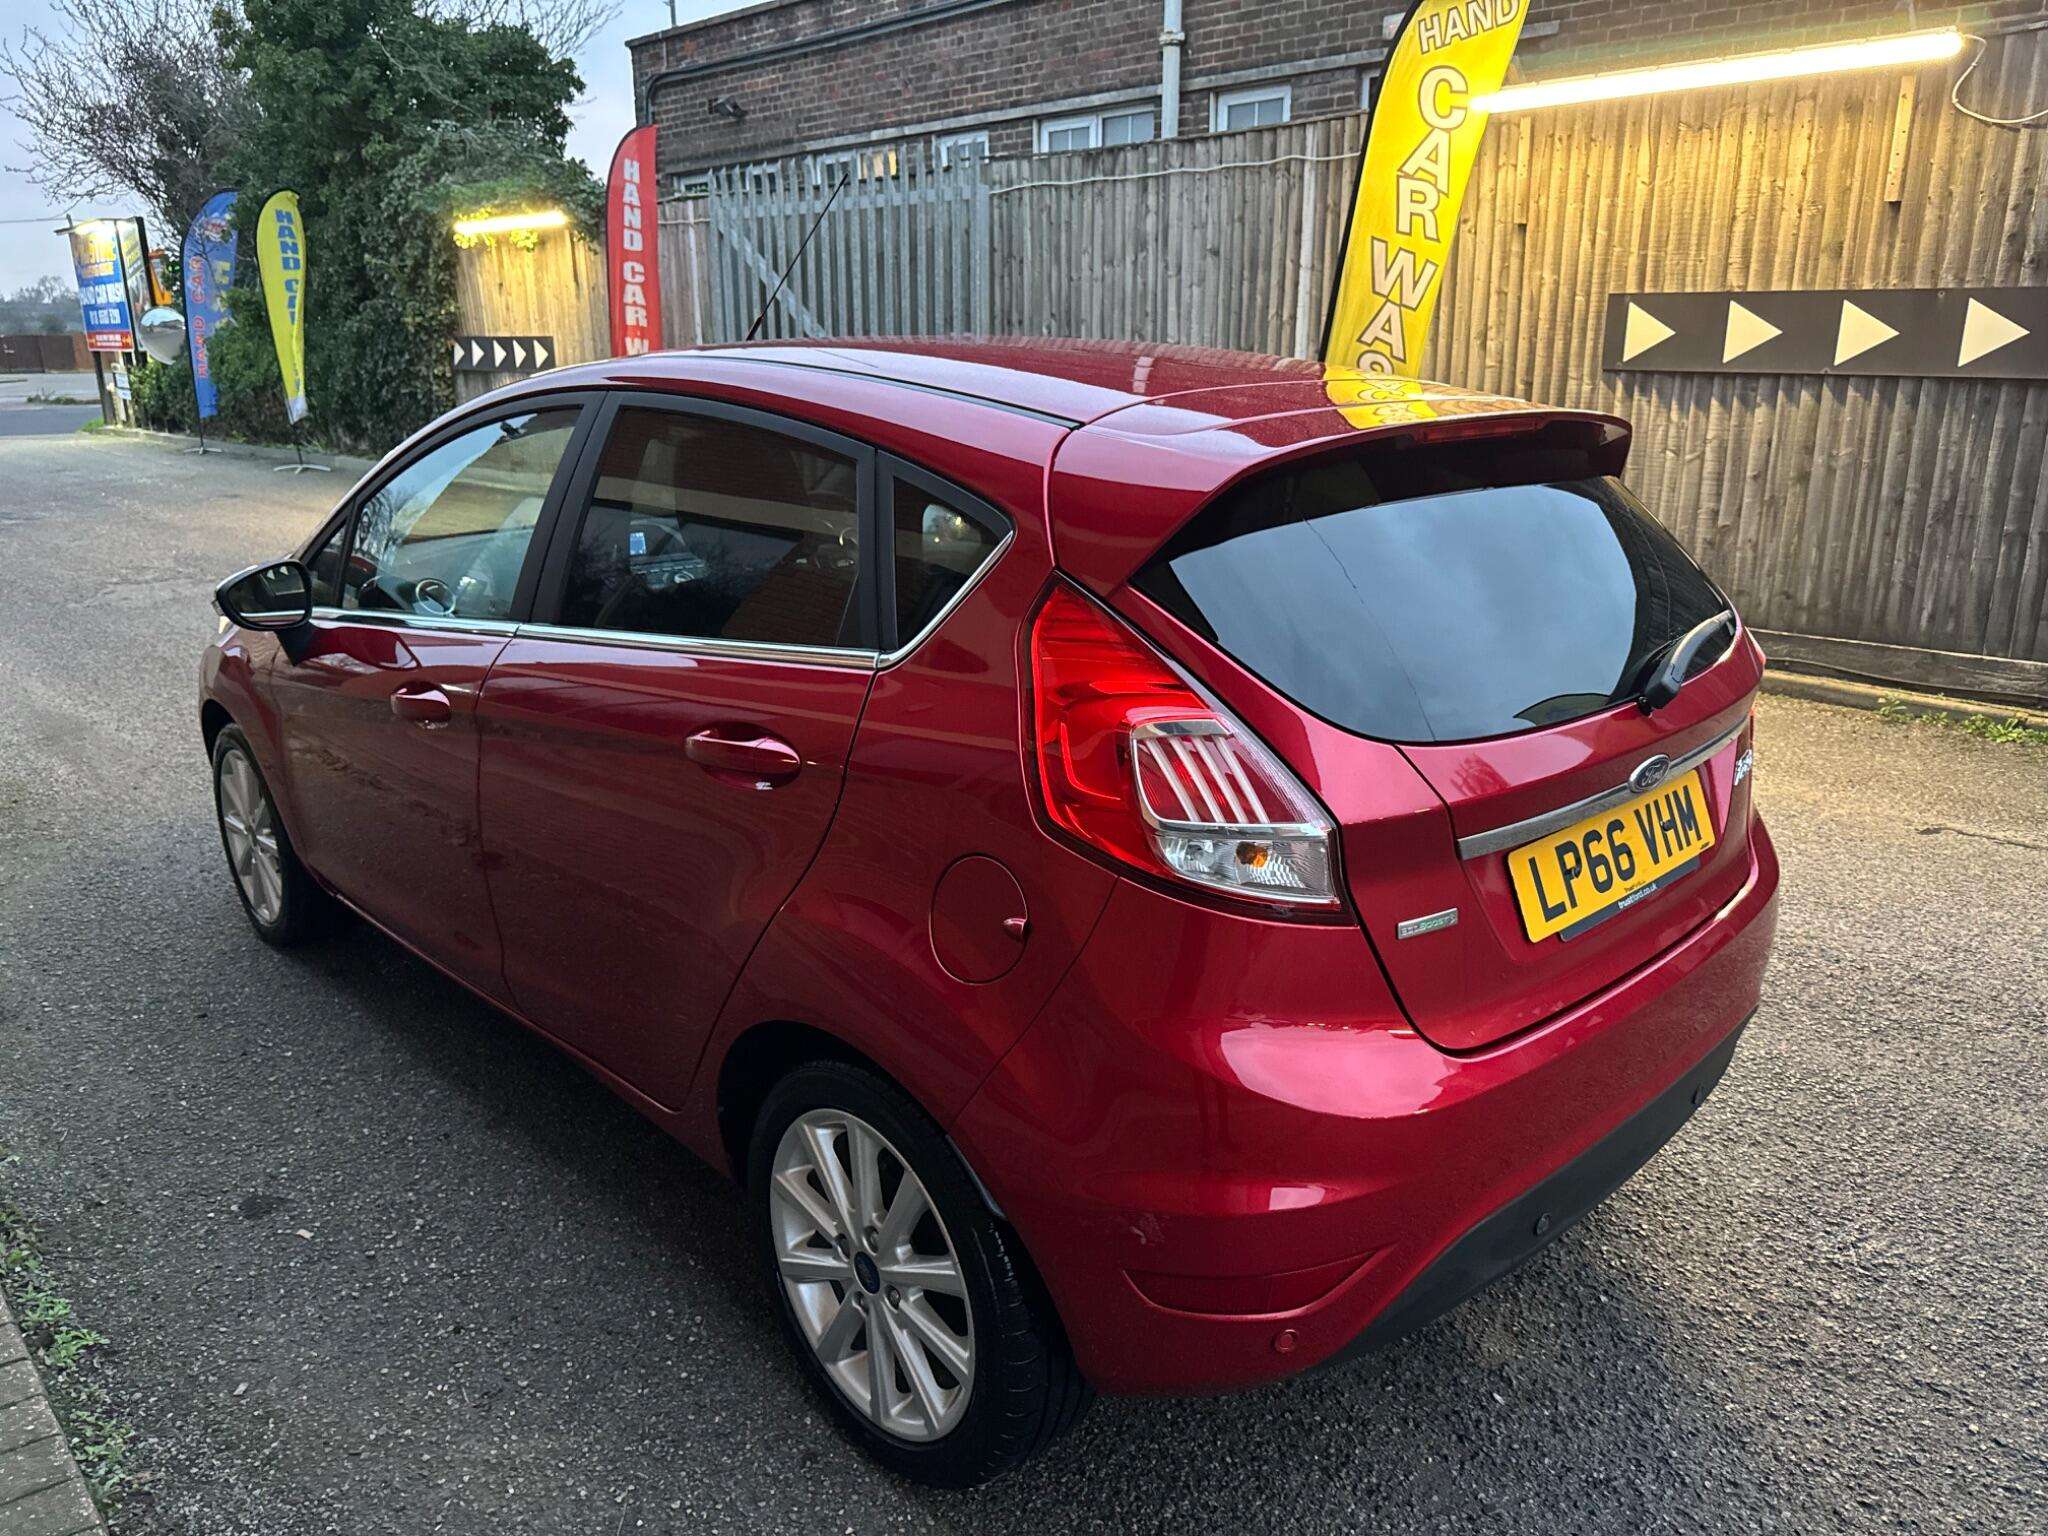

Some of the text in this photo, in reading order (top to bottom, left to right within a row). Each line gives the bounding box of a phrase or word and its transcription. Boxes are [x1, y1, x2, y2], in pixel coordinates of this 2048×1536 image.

[1418, 0, 1519, 54] HAND
[1396, 65, 1468, 242] CAR
[275, 209, 300, 271] HAND
[623, 158, 643, 251] HAND
[623, 261, 648, 327] CAR
[1528, 785, 1702, 923] LP66 VHM
